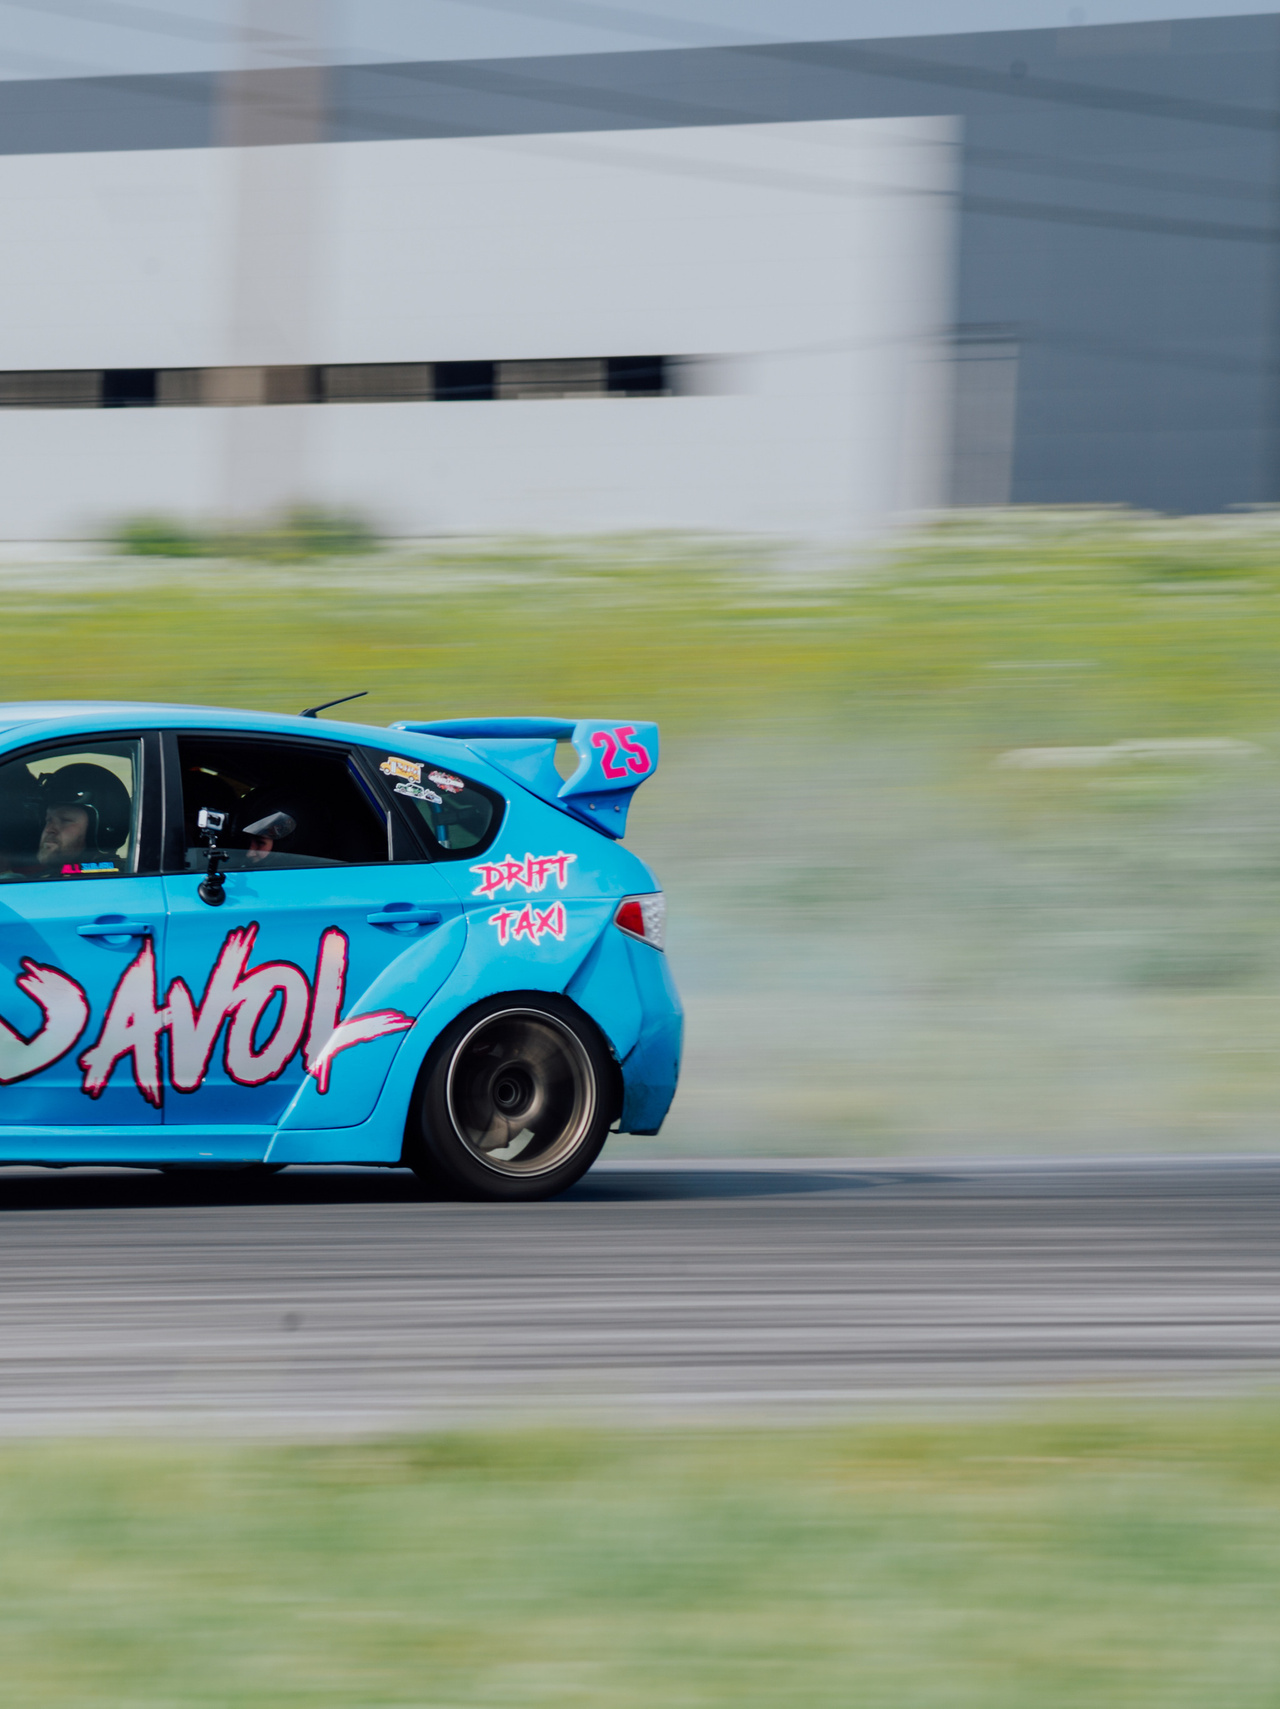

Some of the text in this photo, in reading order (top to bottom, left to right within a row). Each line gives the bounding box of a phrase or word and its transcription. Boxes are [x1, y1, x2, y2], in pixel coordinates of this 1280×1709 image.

[590, 725, 652, 780] 25
[469, 850, 577, 900] DRIFT
[488, 900, 567, 946] TAXI
